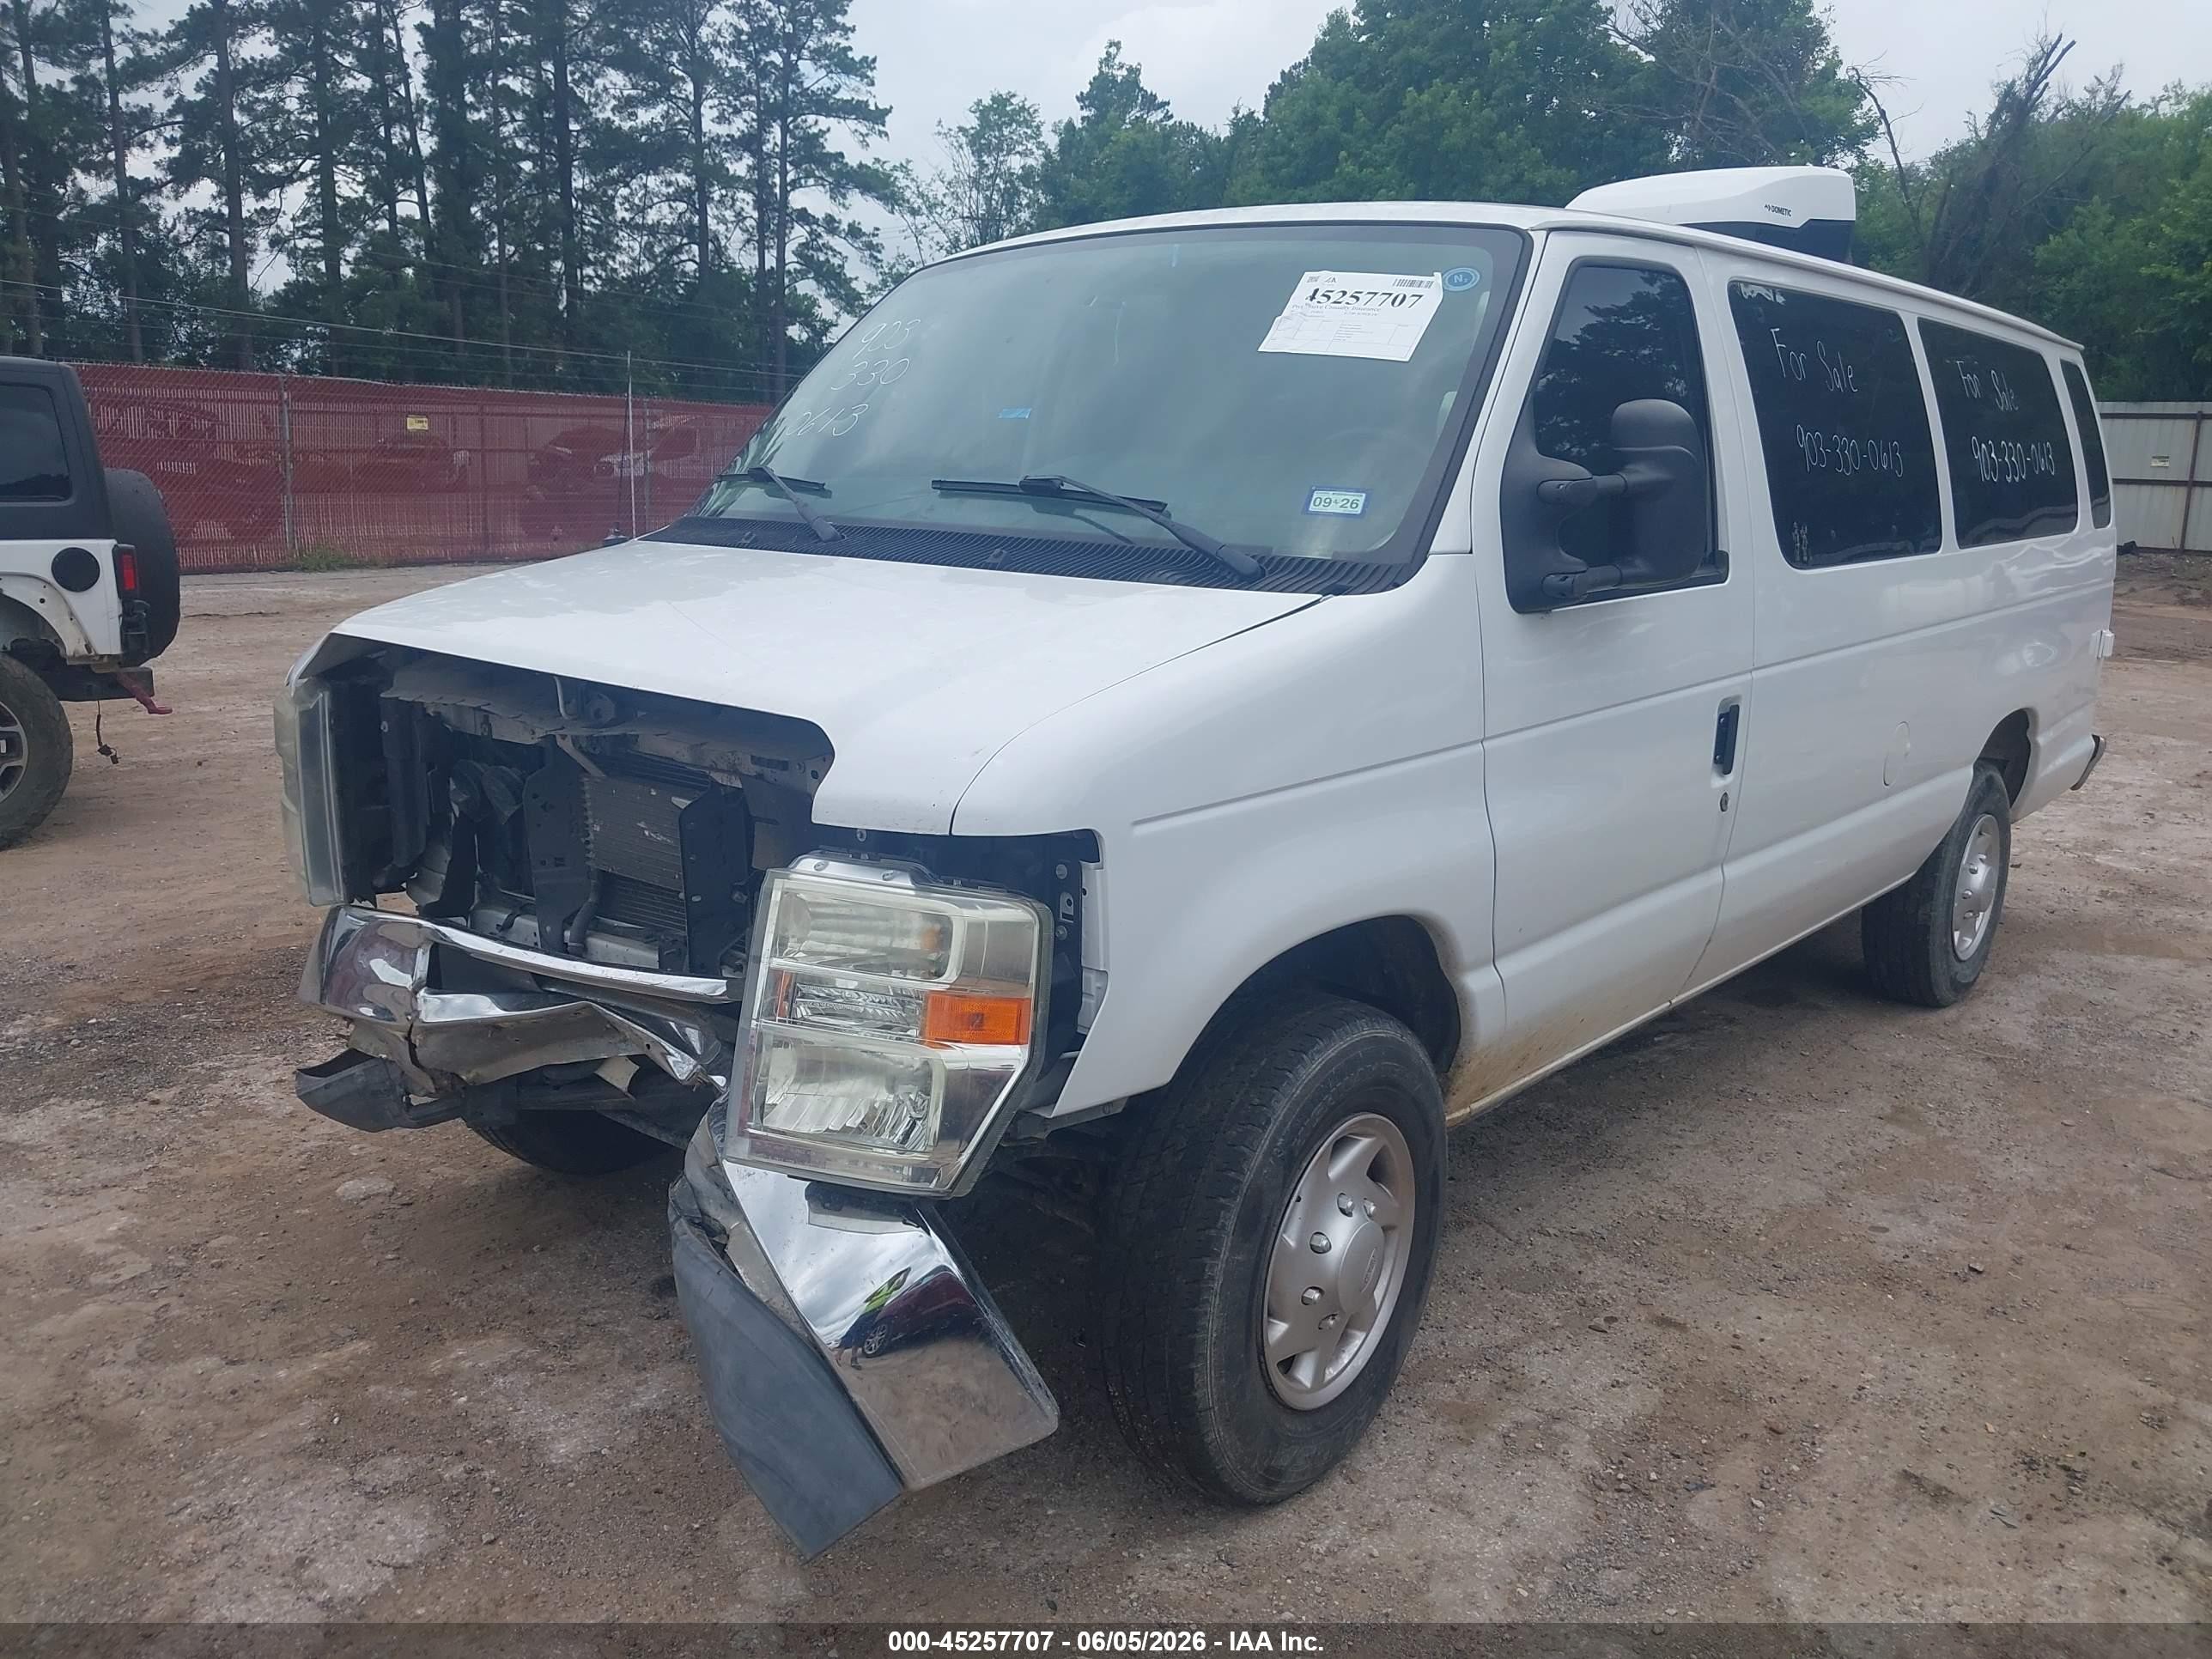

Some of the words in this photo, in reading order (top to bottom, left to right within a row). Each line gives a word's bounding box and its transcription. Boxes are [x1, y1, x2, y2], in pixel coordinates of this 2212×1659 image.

[1771, 205, 1792, 217] DOMETIC
[1305, 287, 1425, 309] 45257707
[830, 357, 911, 391] 330
[1770, 328, 1807, 381] For
[1816, 340, 1858, 392] Sale
[1956, 360, 1982, 399] For
[1990, 369, 2019, 411] Sale
[1796, 424, 1904, 477] 903-330-0613
